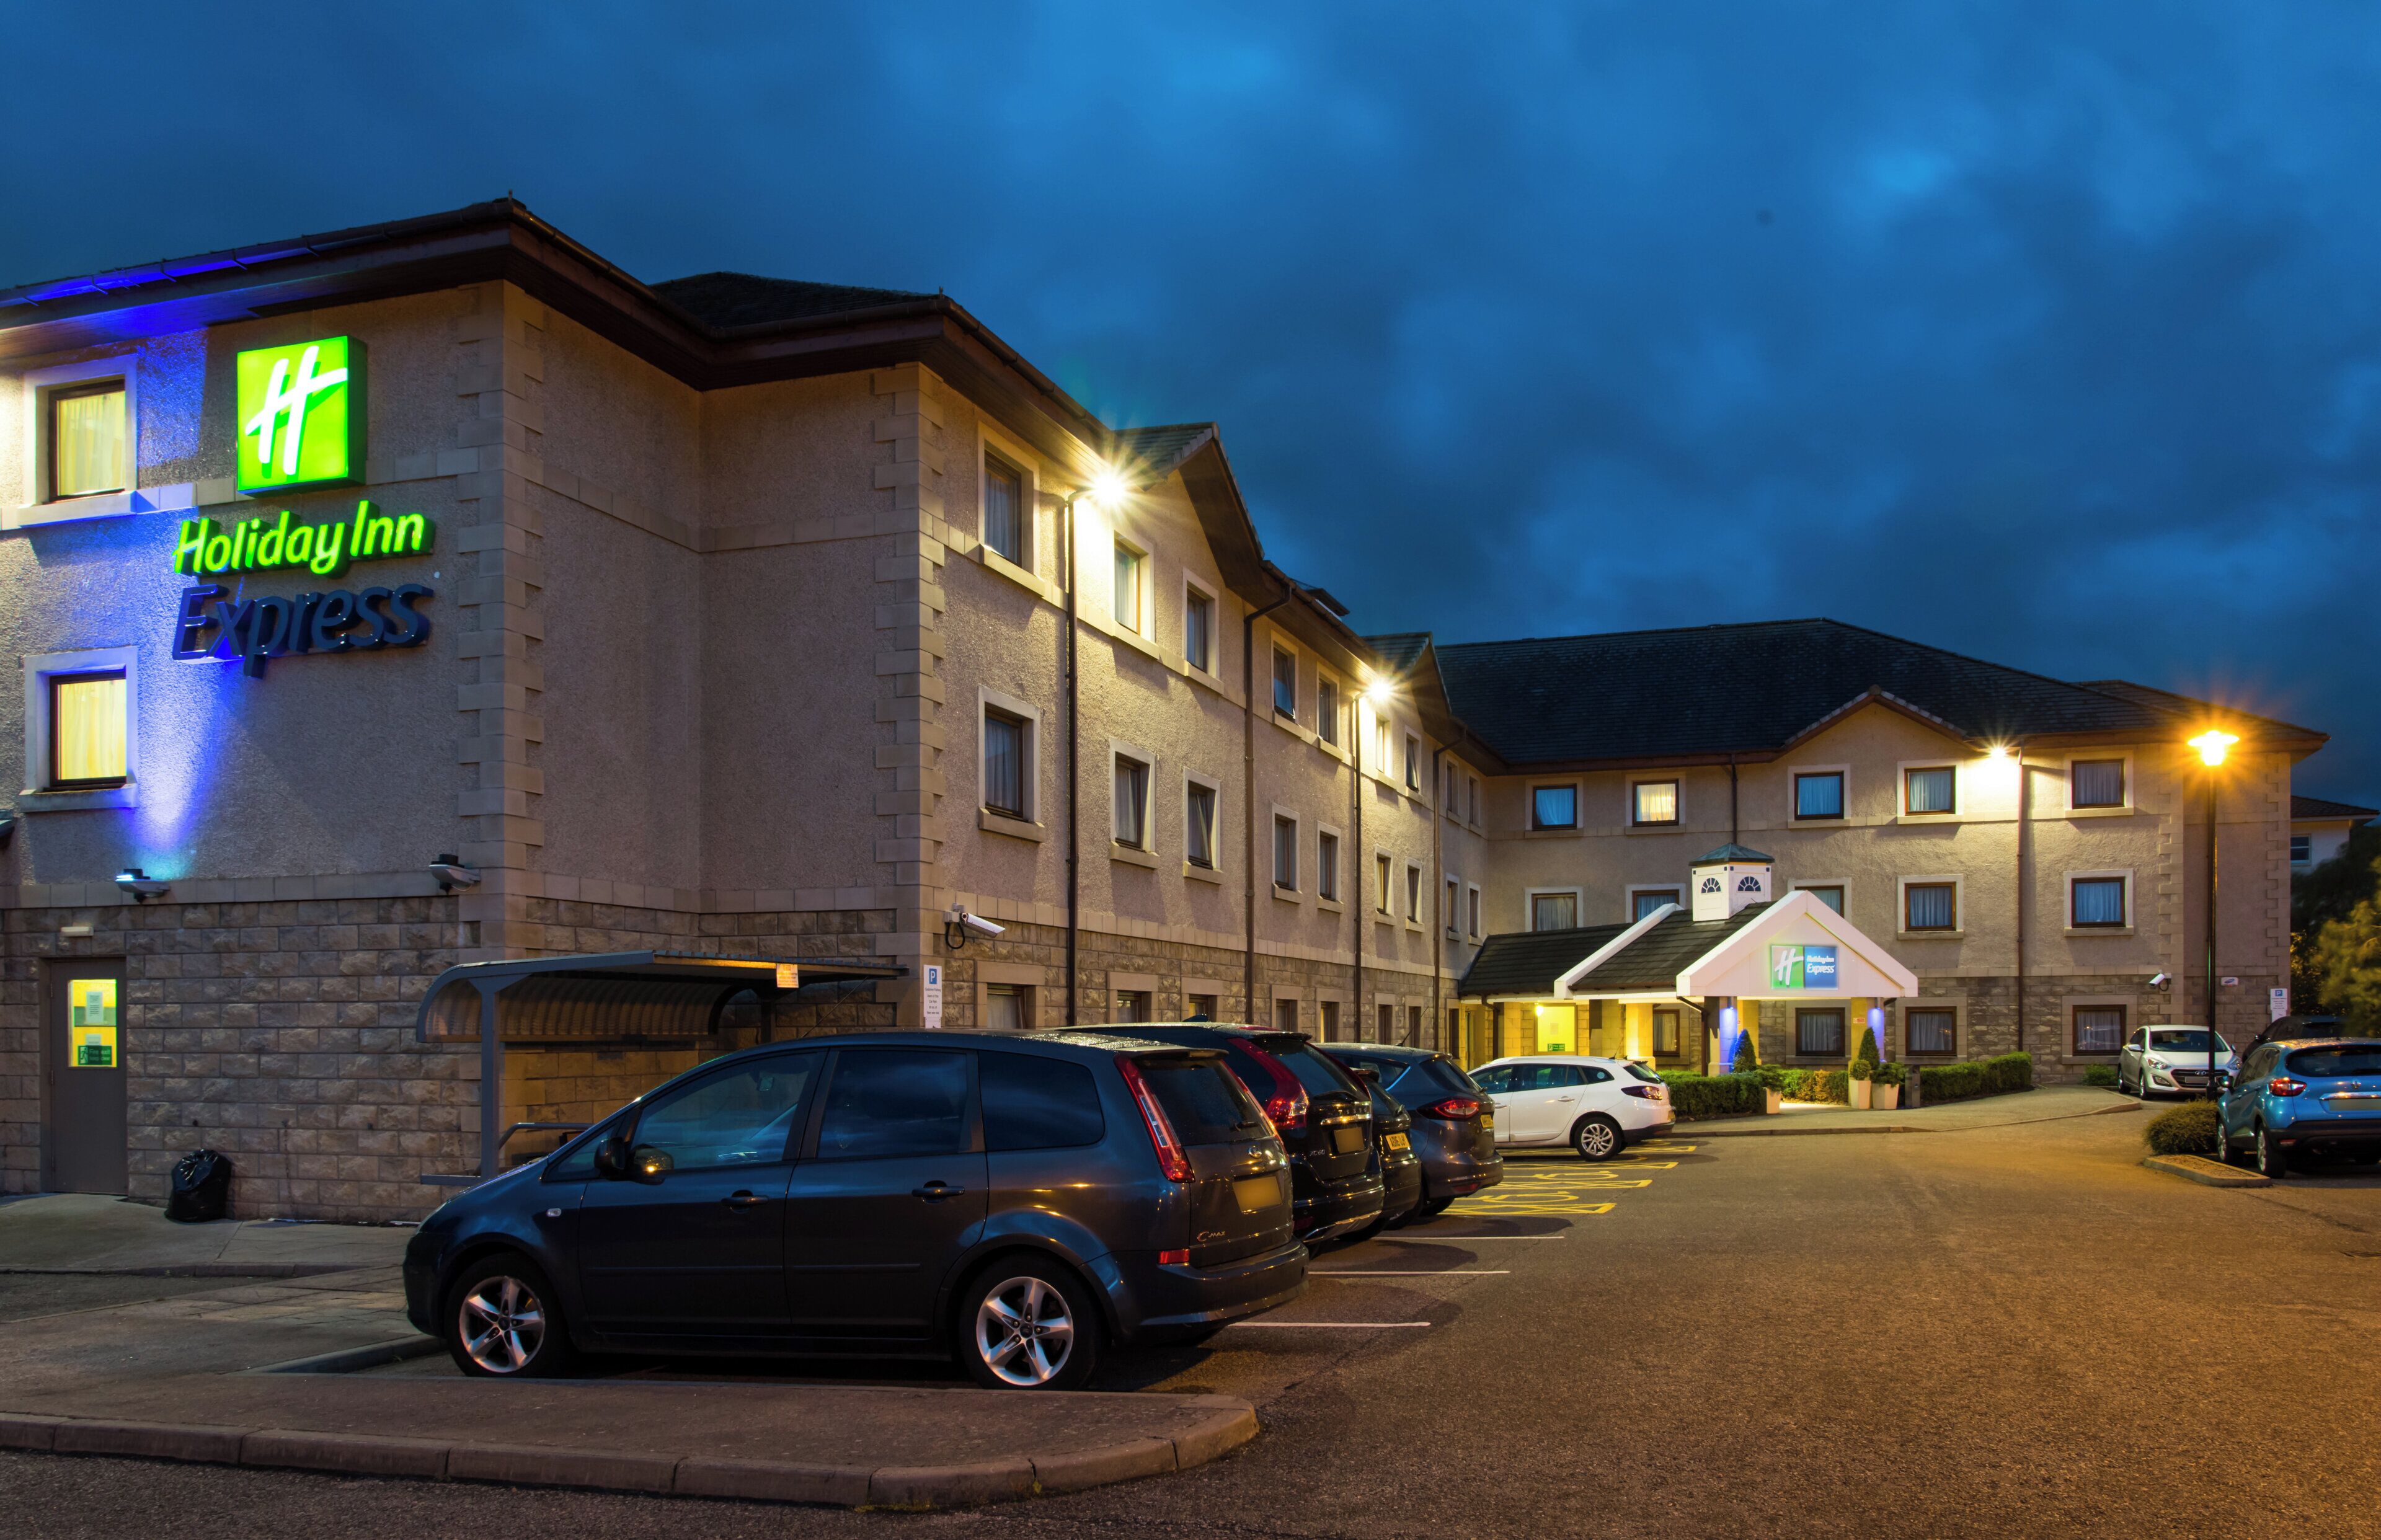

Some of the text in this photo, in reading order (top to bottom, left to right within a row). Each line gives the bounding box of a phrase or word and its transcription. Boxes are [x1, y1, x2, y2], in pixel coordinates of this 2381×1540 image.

[172, 500, 427, 575] Holiday Inn
[172, 583, 434, 679] Express
[1807, 963, 1835, 975] Express
